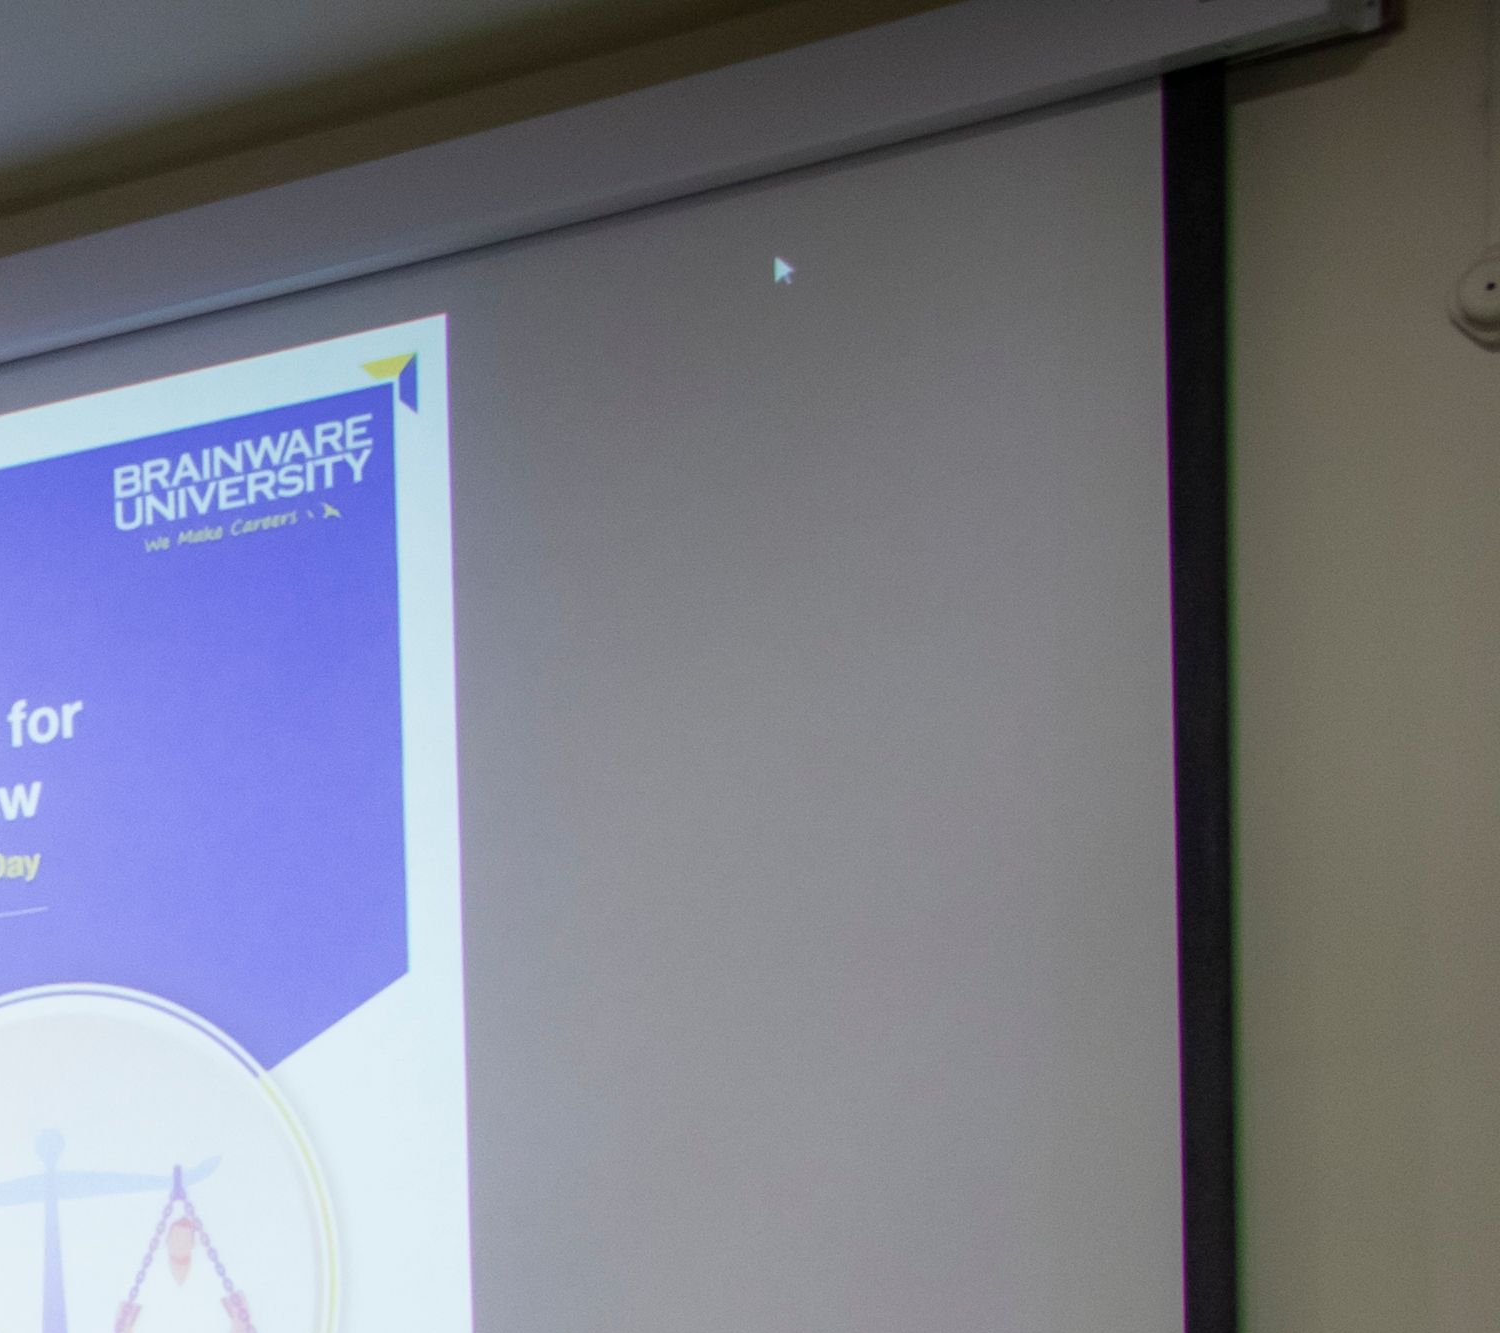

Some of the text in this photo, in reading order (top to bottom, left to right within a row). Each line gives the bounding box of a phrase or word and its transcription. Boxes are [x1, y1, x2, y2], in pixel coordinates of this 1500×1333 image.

[113, 413, 372, 498] BRAINWARE
[115, 449, 372, 531] UNIVERSITY
[8, 699, 84, 748] for
